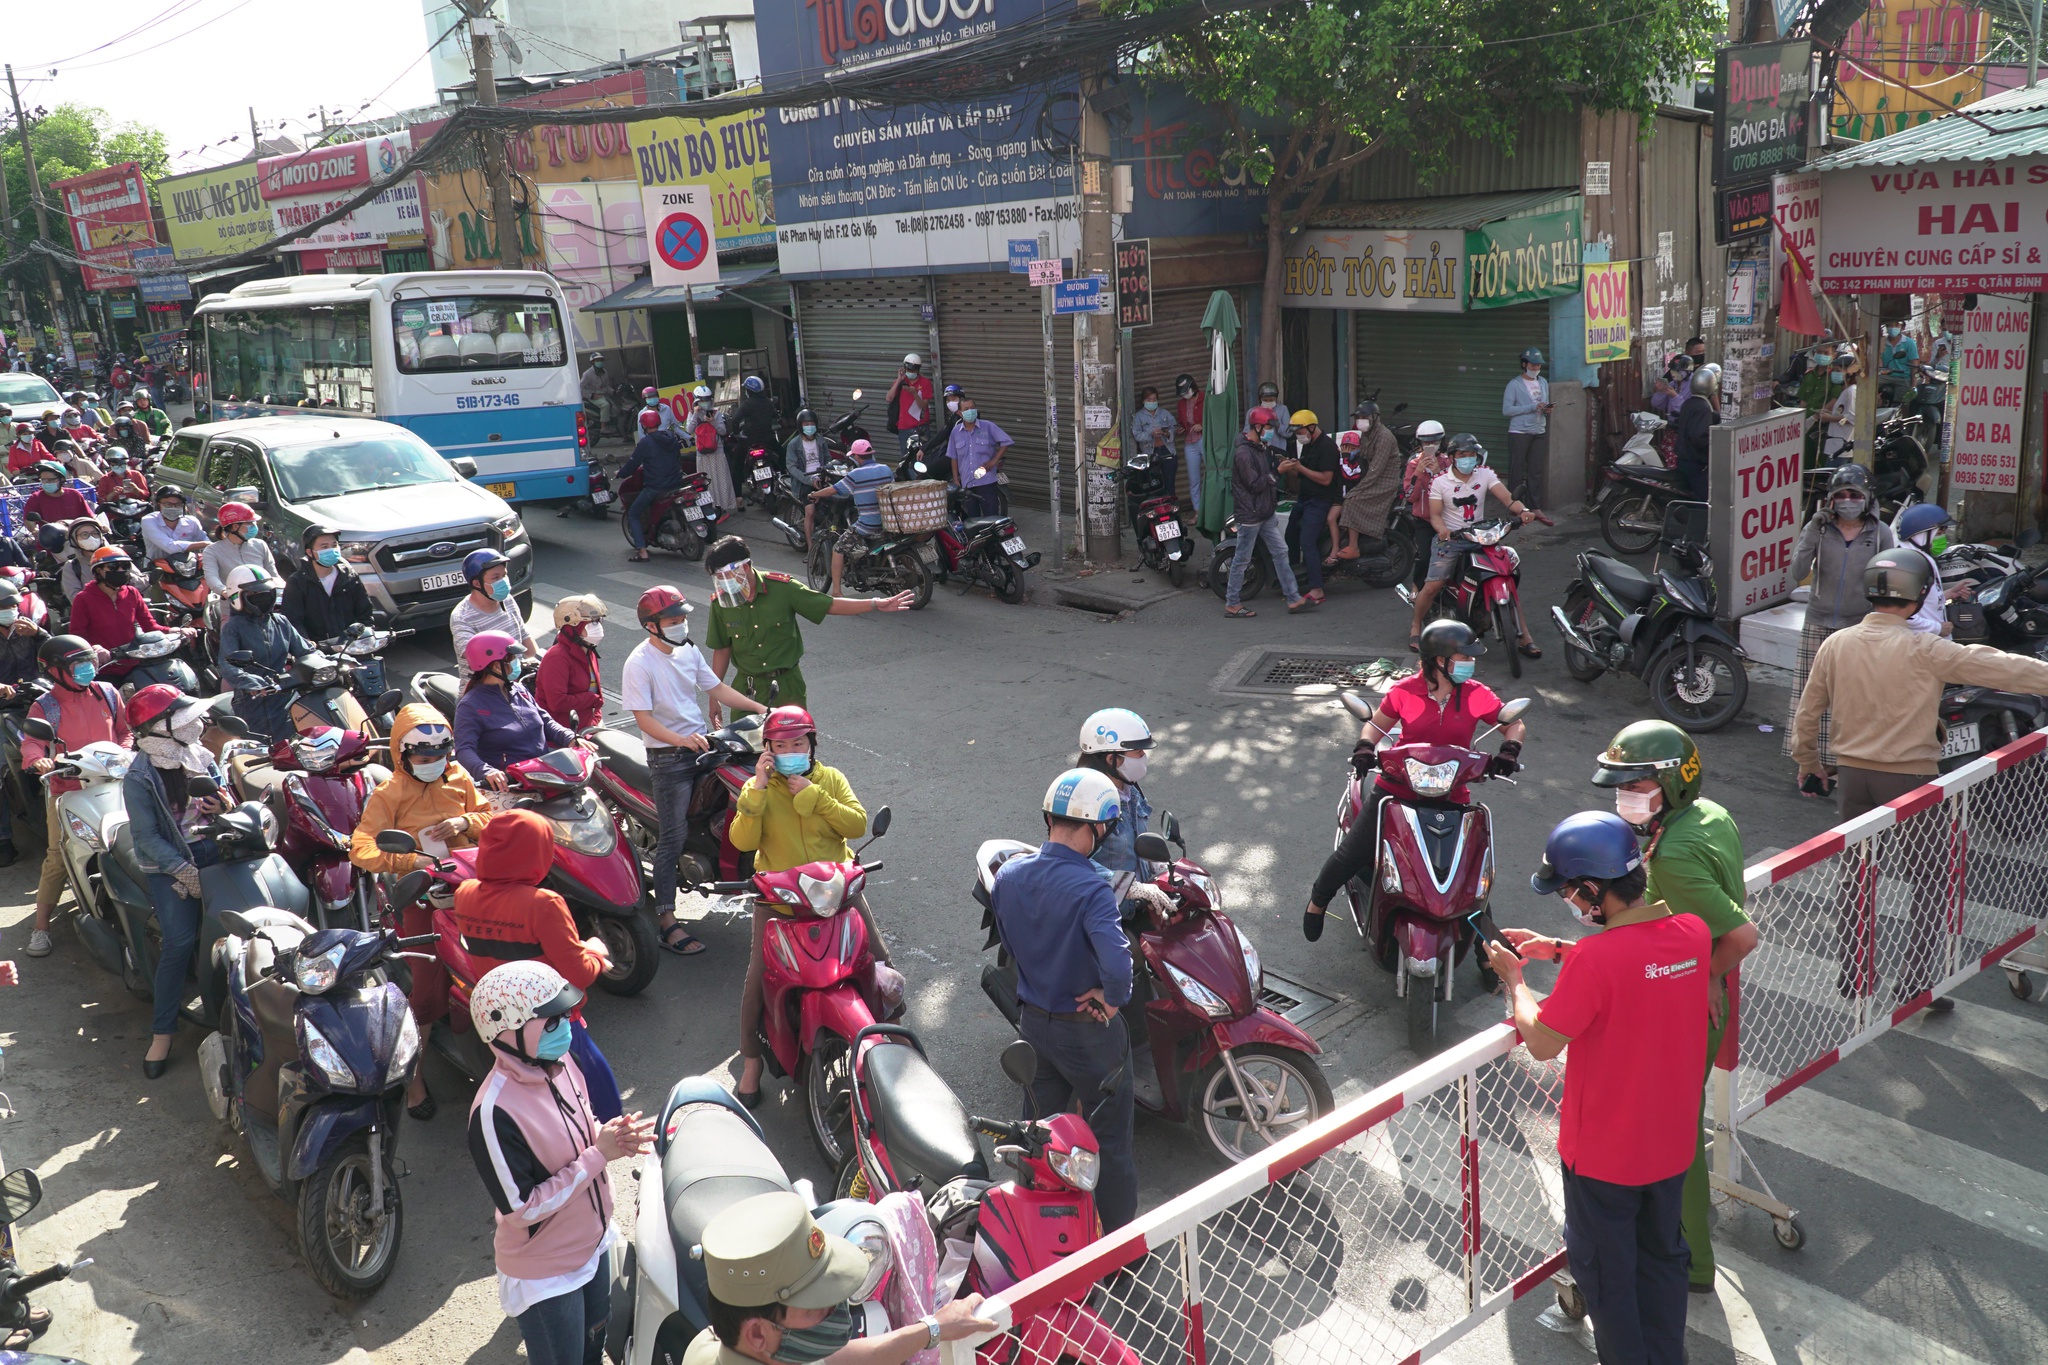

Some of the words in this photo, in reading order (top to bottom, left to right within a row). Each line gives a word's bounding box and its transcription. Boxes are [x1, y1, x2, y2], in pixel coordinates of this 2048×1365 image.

[918, 36, 933, 48] TINH
[976, 21, 996, 34] NGHI
[833, 127, 876, 149] CHUYÊN
[879, 121, 902, 141] SẢN
[905, 113, 935, 137] XUẤT
[1730, 119, 1767, 148] BÓNG
[1770, 112, 1787, 140] ĐÁ
[637, 130, 684, 186] BÚN
[684, 117, 716, 178] BÒ
[846, 163, 867, 180] Công
[868, 157, 895, 178] nghiệp
[897, 156, 907, 170] và
[908, 153, 926, 169] Dân
[930, 151, 951, 169] dụng
[968, 144, 992, 162] Song
[996, 141, 1026, 161] ngang
[1733, 152, 1758, 171] 0706
[1760, 147, 1783, 165] 8888
[282, 162, 319, 186] MOTO
[320, 155, 357, 180] ZONE
[1870, 168, 1940, 195] VỰA
[1953, 161, 2015, 187] HẢI
[662, 193, 695, 205] ZONE
[799, 194, 819, 208] Nhôm
[821, 191, 836, 206] siêu
[865, 186, 877, 200] CN
[878, 184, 896, 199] Đức
[904, 179, 922, 196] Tấm
[940, 176, 954, 192] CN
[956, 171, 968, 190] Úc
[718, 182, 754, 234] LỘC
[1729, 191, 1750, 221] VÀO
[1777, 196, 1820, 225] TÔM
[1918, 202, 2020, 236] HAI
[790, 229, 807, 243] Phan
[808, 228, 822, 243] Huy
[851, 223, 862, 237] Gò
[863, 220, 877, 238] Vấp
[1118, 245, 1147, 269] HỚT
[1469, 239, 1511, 299] HỚT
[1515, 232, 1549, 293] TÓC
[1552, 221, 1579, 286] HẢI
[1828, 247, 1899, 270] CHUYÊN
[1904, 249, 1953, 266] CUNG
[1957, 242, 1996, 266] CẤP
[2026, 247, 2042, 264] &
[1120, 272, 1148, 294] TÓC
[1284, 245, 1337, 296] HỚT
[1342, 245, 1397, 298] TÓC
[1403, 241, 1457, 299] HẢI
[1842, 280, 1861, 290] 142
[1864, 279, 1892, 289] PHAN
[1893, 279, 1914, 289] HUY
[1917, 275, 1935, 288] ÍCH
[1944, 278, 1969, 288] P.15
[1978, 275, 2017, 289] Q.TÂN
[2018, 274, 2042, 288] BÌNH
[1066, 281, 1089, 291] ĐƯỜNG
[1585, 262, 1628, 321] CƠM
[1123, 298, 1148, 323] HẢI
[1966, 306, 1993, 333] TÔM
[1996, 306, 2029, 333] CÀNG
[1588, 323, 1608, 345] BÌNH
[1610, 323, 1626, 342] DÂN
[1963, 344, 1999, 370] TÔM
[2003, 344, 2025, 371] SÚ
[1961, 385, 1988, 406] CUA
[1993, 386, 2022, 412] GHẸ
[1965, 422, 1985, 442] BA
[1990, 423, 2011, 444] BA
[1956, 452, 1978, 466] 0903
[1980, 454, 1997, 467] 656
[1999, 455, 2016, 468] 531
[1738, 452, 1799, 499] TÔM
[1955, 470, 1977, 484] 0936
[1979, 471, 1996, 485] 527
[1998, 473, 2015, 486] 983
[1741, 497, 1795, 540] CUA
[1740, 537, 1794, 582] GHẸ
[1760, 588, 1769, 601] &
[466, 924, 503, 936] VERY
[1650, 965, 1670, 979] KTG
[1670, 959, 1697, 972] Electric
